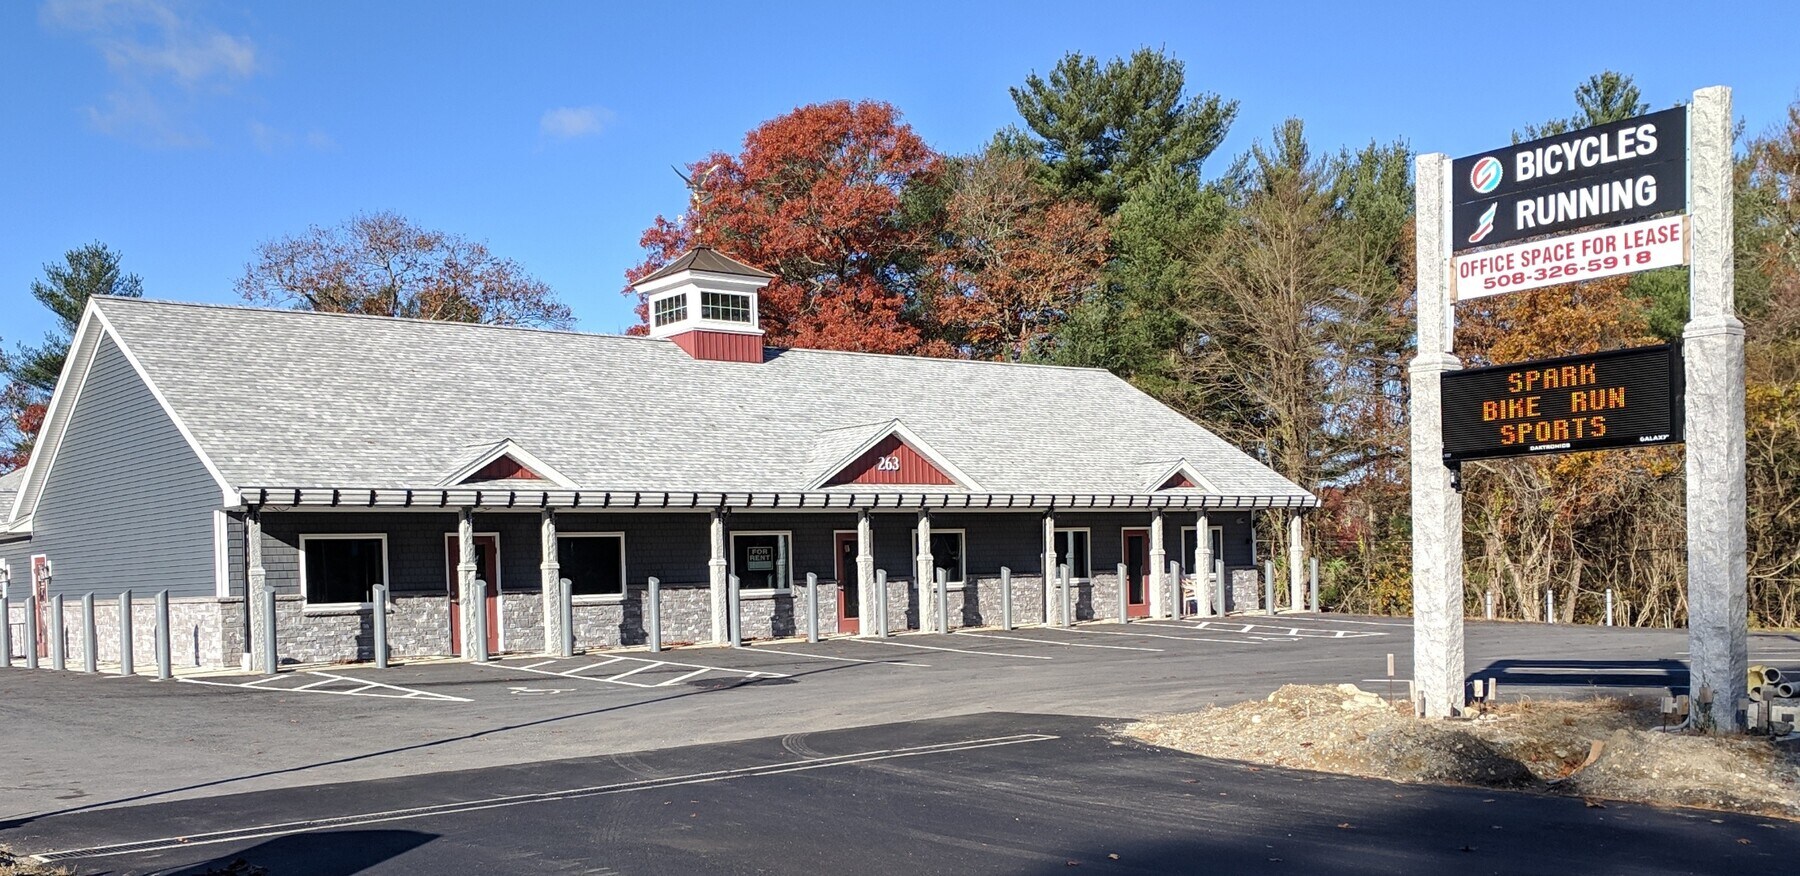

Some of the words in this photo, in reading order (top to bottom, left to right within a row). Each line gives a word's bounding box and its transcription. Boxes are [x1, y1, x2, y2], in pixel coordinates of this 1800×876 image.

[1516, 123, 1658, 181] BICYCLES
[1516, 175, 1657, 230] RUNNING
[1460, 254, 1515, 278] OFFICE
[1521, 243, 1576, 267] SPACE
[1582, 234, 1616, 256] FOR
[1624, 223, 1680, 249] LEASE
[1483, 251, 1652, 289] 508-326-5918
[1508, 363, 1596, 393] SPARK
[1483, 396, 1541, 422] BIKE
[1571, 387, 1625, 412] RUN
[1500, 416, 1606, 445] SPORTS
[878, 456, 900, 472] 263
